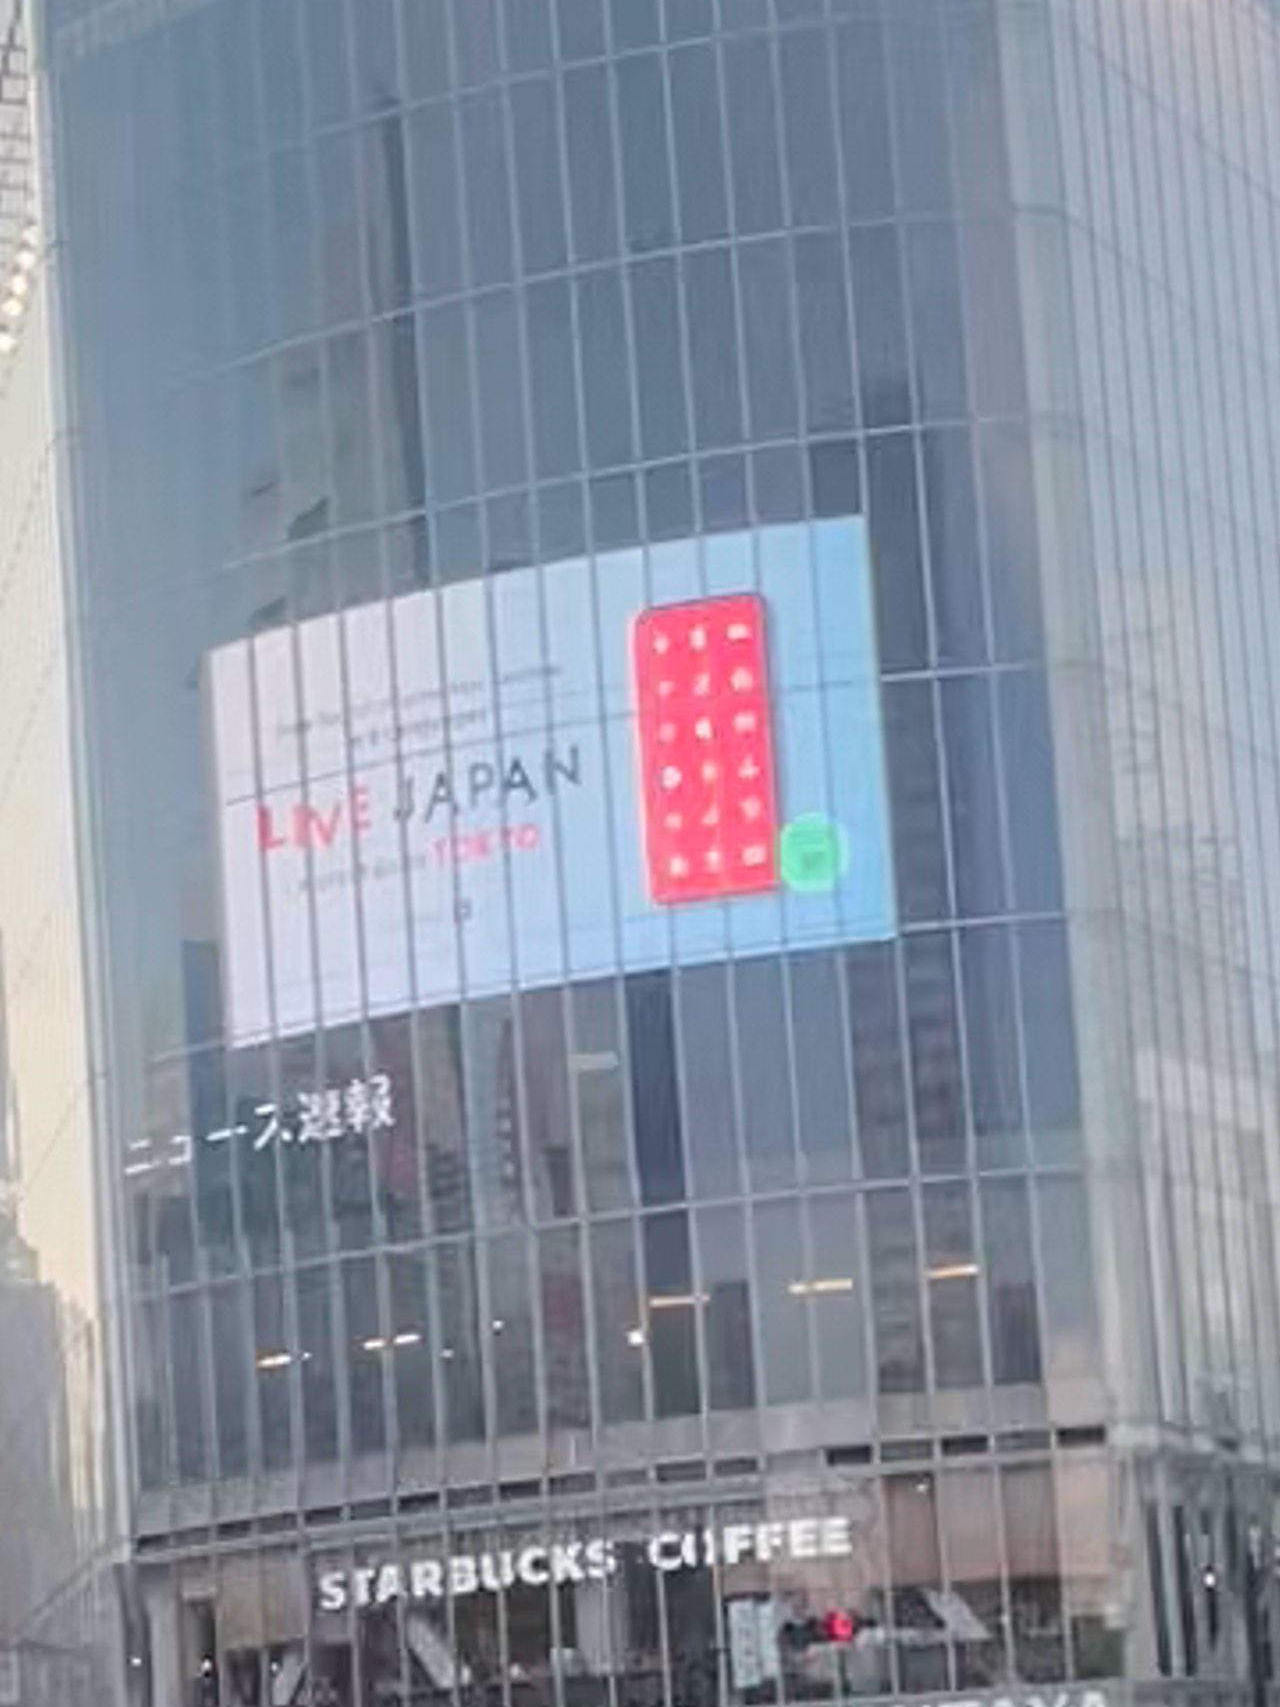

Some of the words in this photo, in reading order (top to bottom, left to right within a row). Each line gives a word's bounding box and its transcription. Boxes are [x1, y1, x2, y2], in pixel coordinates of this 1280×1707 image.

[254, 783, 373, 853] LIVE
[393, 743, 583, 826] JAPAN
[320, 1539, 618, 1610] STARBUCKS
